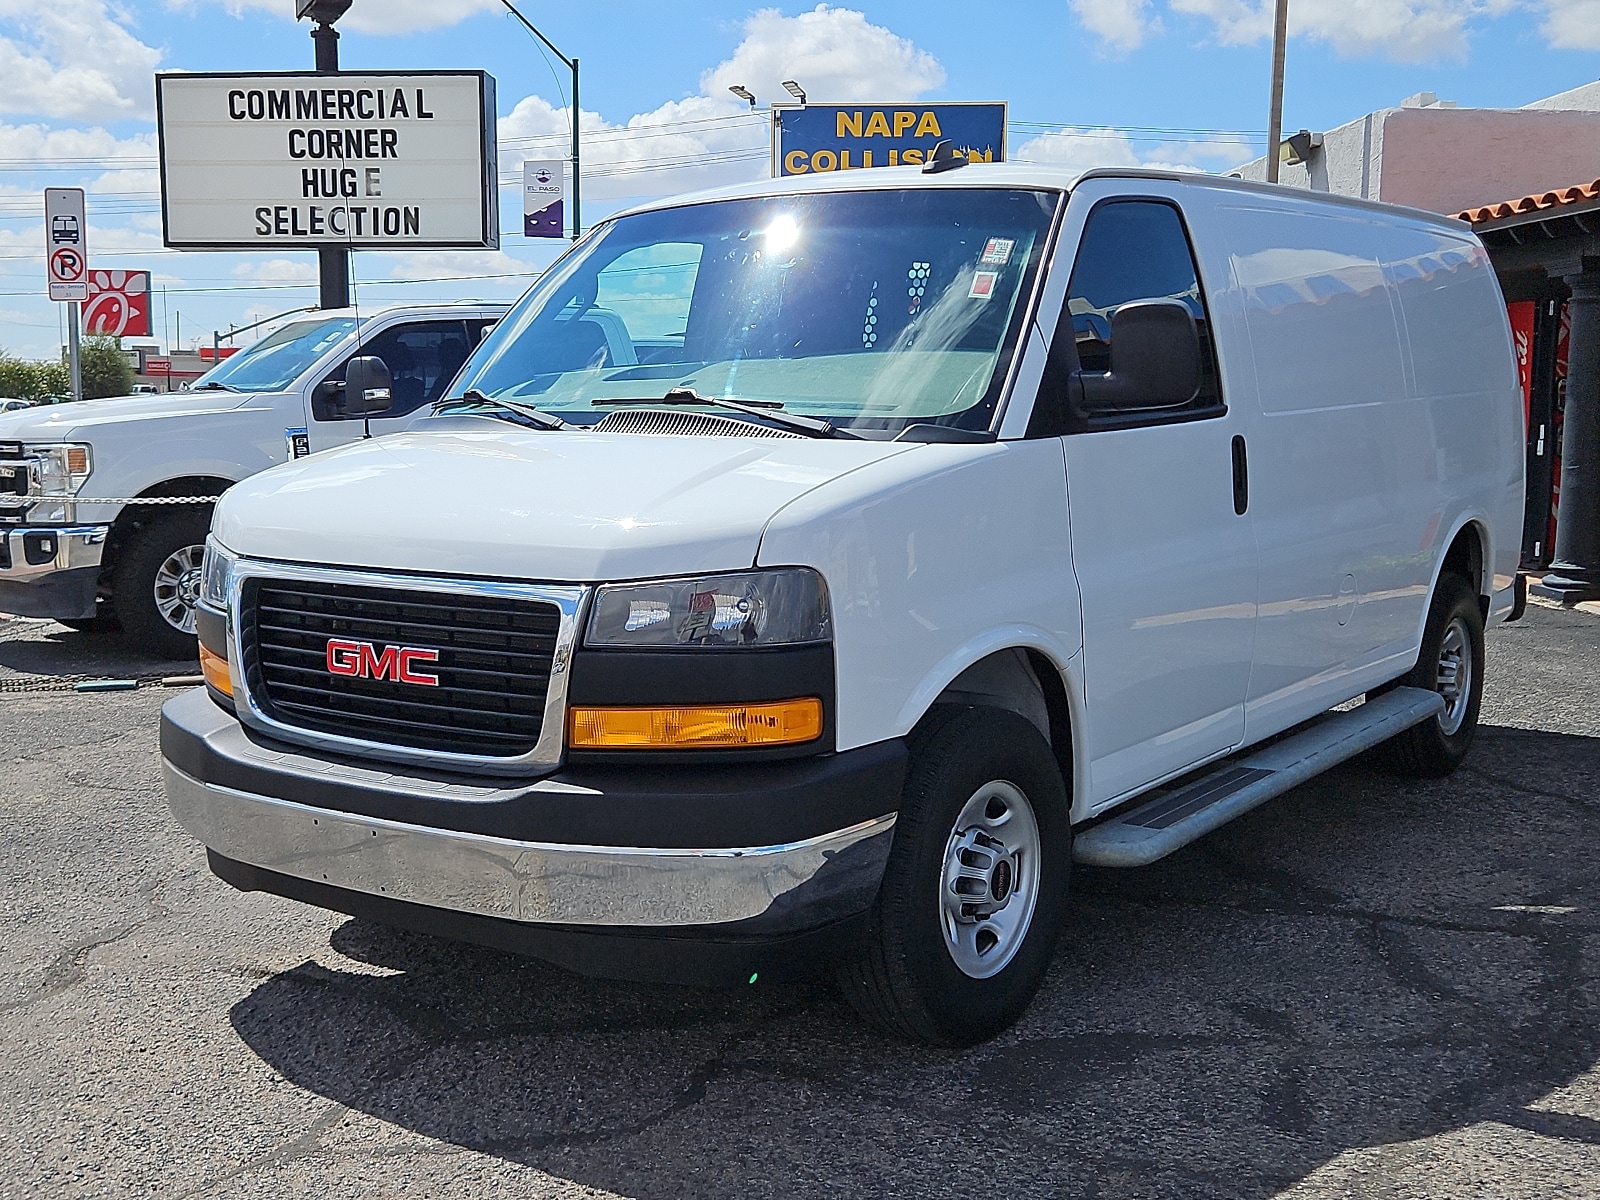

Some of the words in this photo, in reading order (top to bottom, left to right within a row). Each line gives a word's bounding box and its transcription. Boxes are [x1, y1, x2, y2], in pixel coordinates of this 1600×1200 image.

[228, 88, 434, 120] COMMERCIAL
[836, 111, 942, 138] NAPA
[288, 128, 398, 159] CORNER
[784, 149, 993, 174] COLLISN
[301, 167, 382, 198] HUGE
[255, 206, 420, 236] SELECTION
[295, 437, 309, 458] F2
[326, 638, 440, 687] GMC
